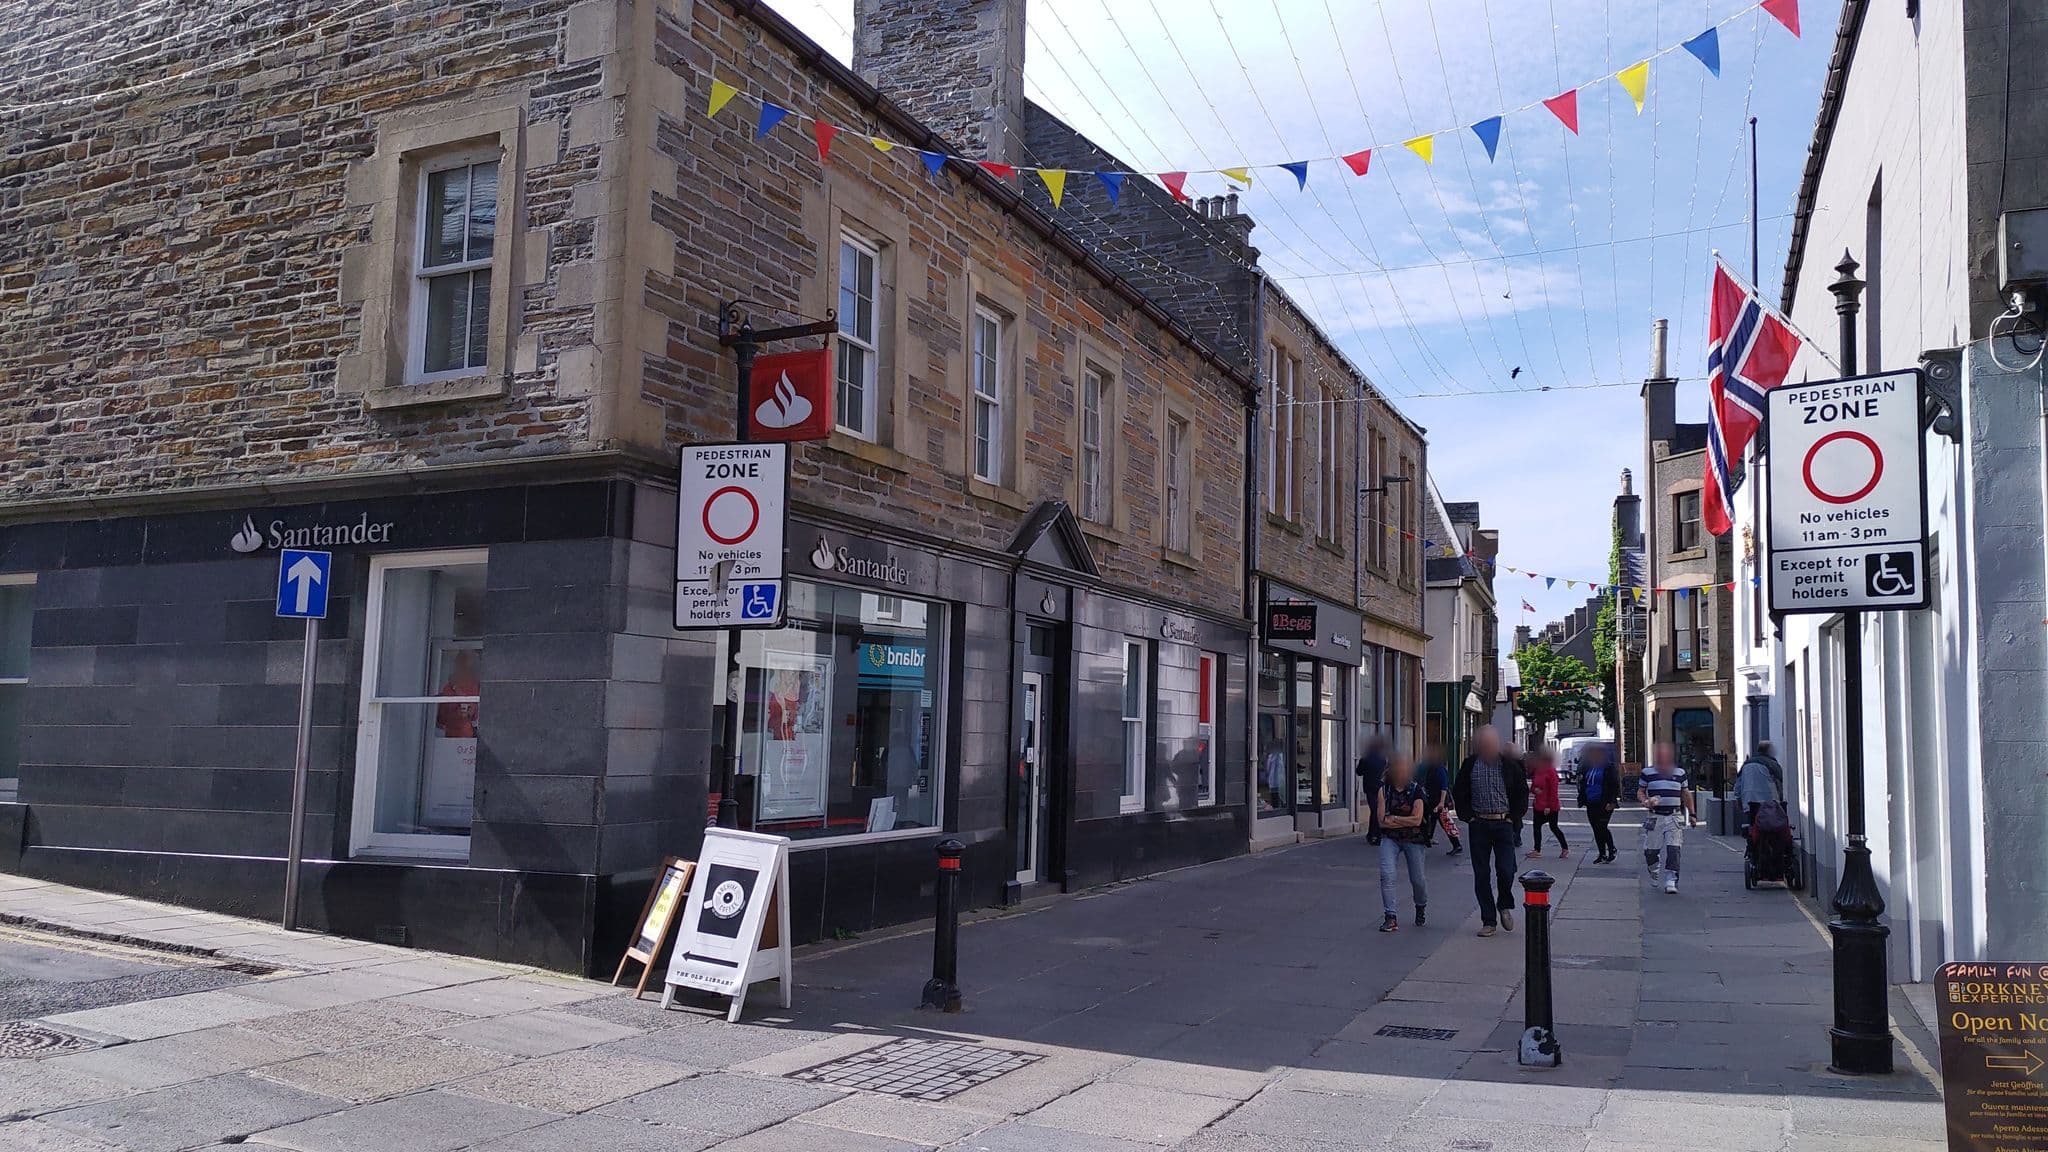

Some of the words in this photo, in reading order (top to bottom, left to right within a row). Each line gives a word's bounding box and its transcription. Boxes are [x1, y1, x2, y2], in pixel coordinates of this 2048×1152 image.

[1789, 380, 1895, 405] PEDESTRIAN
[1803, 398, 1879, 424] ZONE
[696, 449, 771, 461] PEDESTRIAN
[705, 463, 759, 479] ZONE
[1800, 512, 1821, 524] No
[1826, 507, 1890, 522] vehicles
[268, 511, 394, 549] Santander
[698, 550, 714, 560] No
[718, 550, 762, 559] vehicles
[837, 546, 911, 585] Santander
[1780, 557, 1832, 571] Except
[1837, 556, 1859, 568] for
[1795, 571, 1845, 587] permit
[683, 586, 713, 597] Exce
[726, 586, 740, 595] or
[1792, 586, 1849, 600] holders
[690, 609, 731, 619] holders
[1945, 964, 1997, 978] FAMILY
[2006, 965, 2032, 978] FUN
[1962, 994, 2048, 1004] EXPERIENC
[1952, 1012, 2013, 1036] Open
